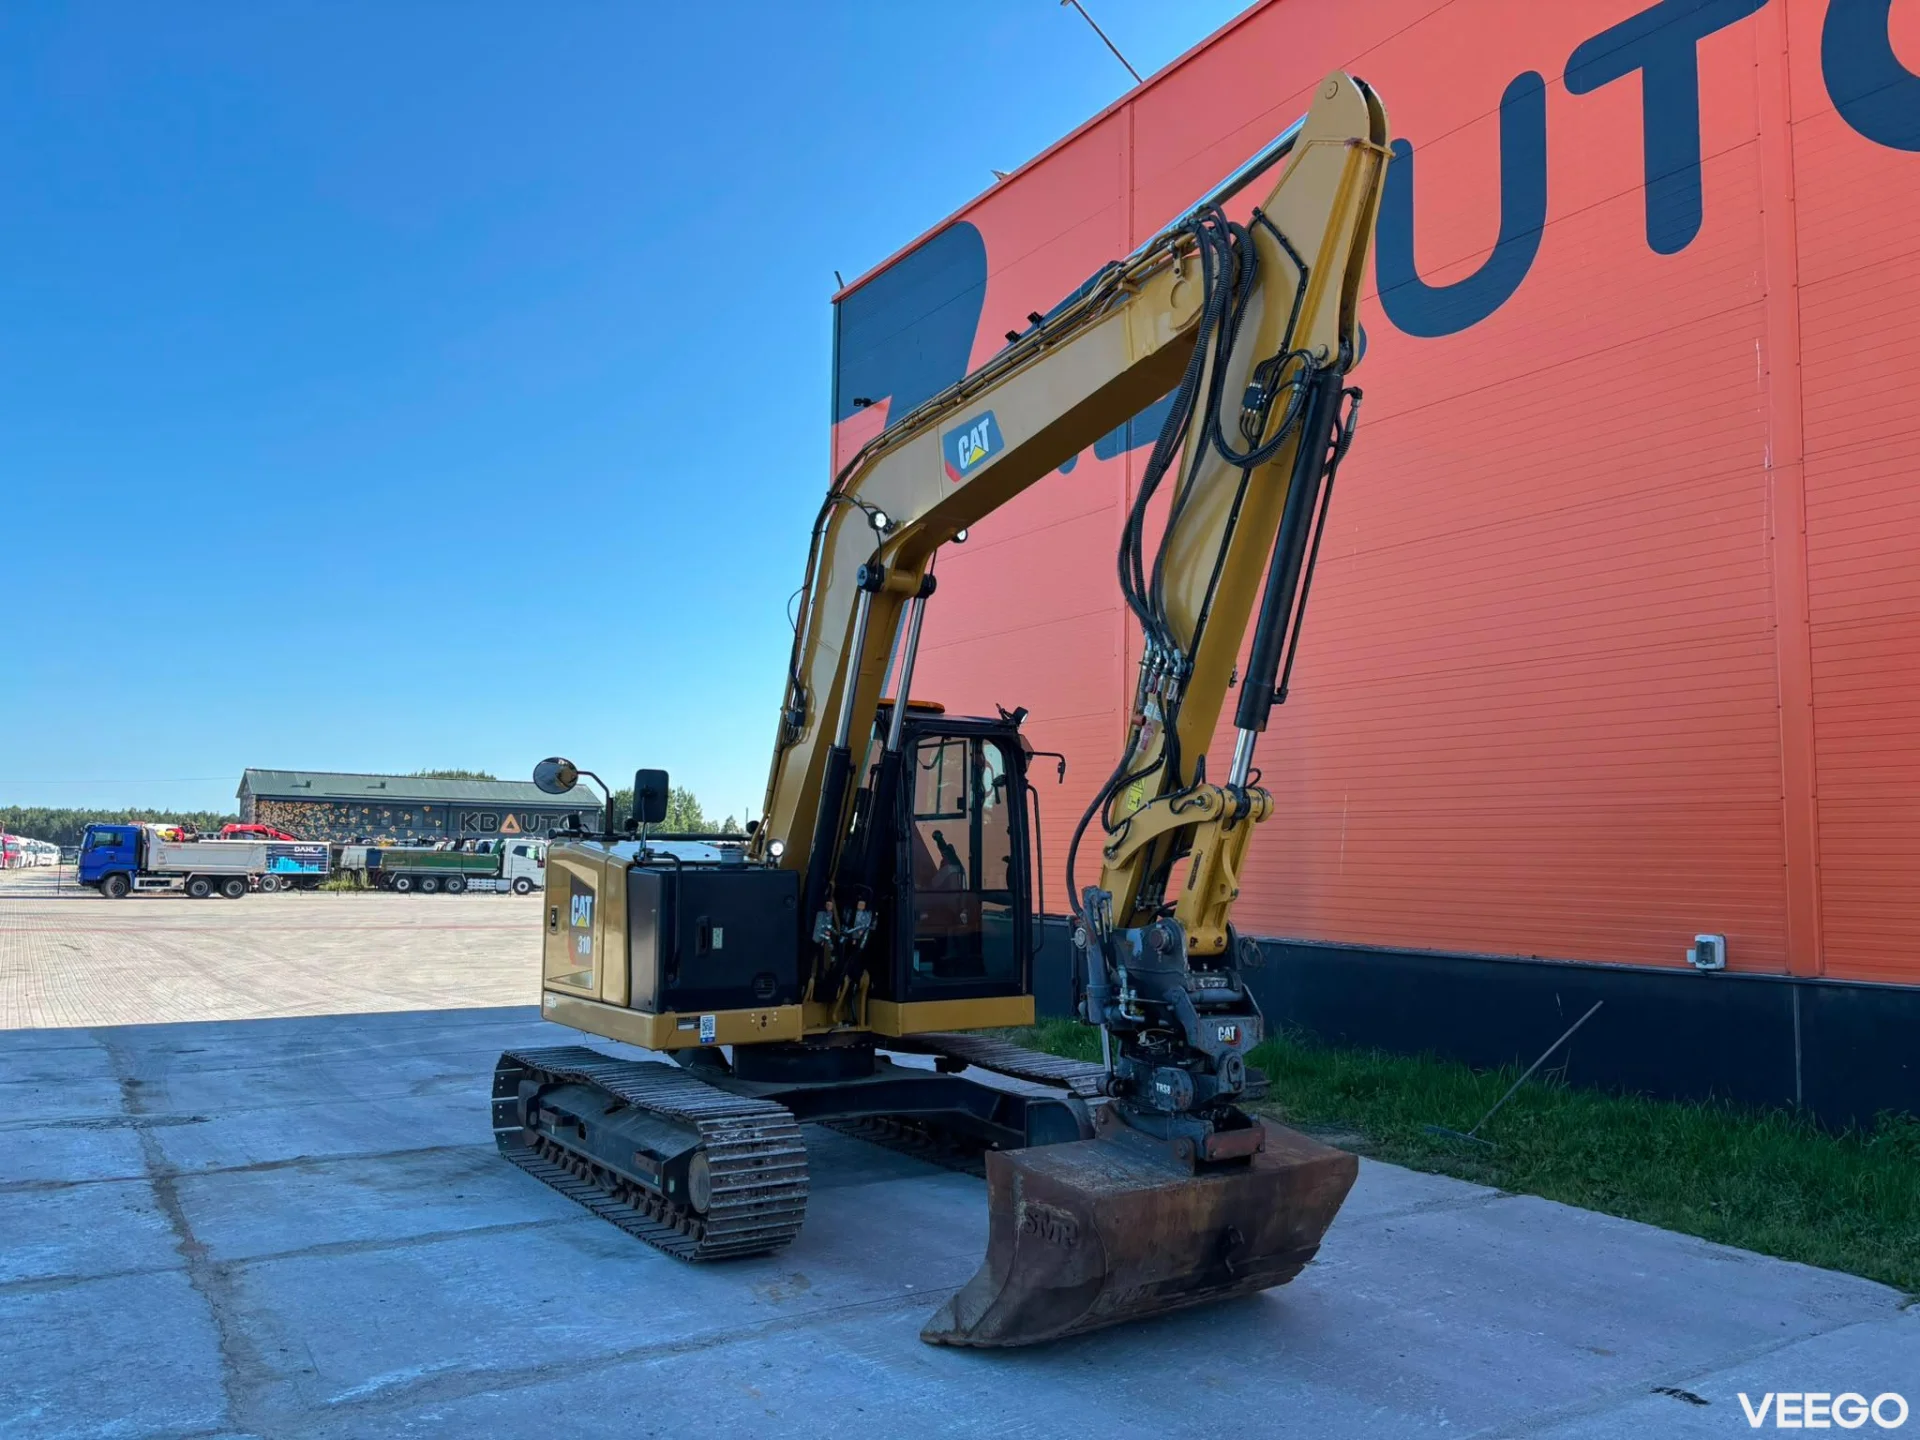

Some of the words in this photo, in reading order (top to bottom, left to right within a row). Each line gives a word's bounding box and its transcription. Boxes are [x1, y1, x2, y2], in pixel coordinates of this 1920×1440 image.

[958, 418, 989, 470] CAT
[571, 894, 593, 928] CAT
[577, 935, 591, 954] 310
[1218, 1026, 1236, 1041] CAT
